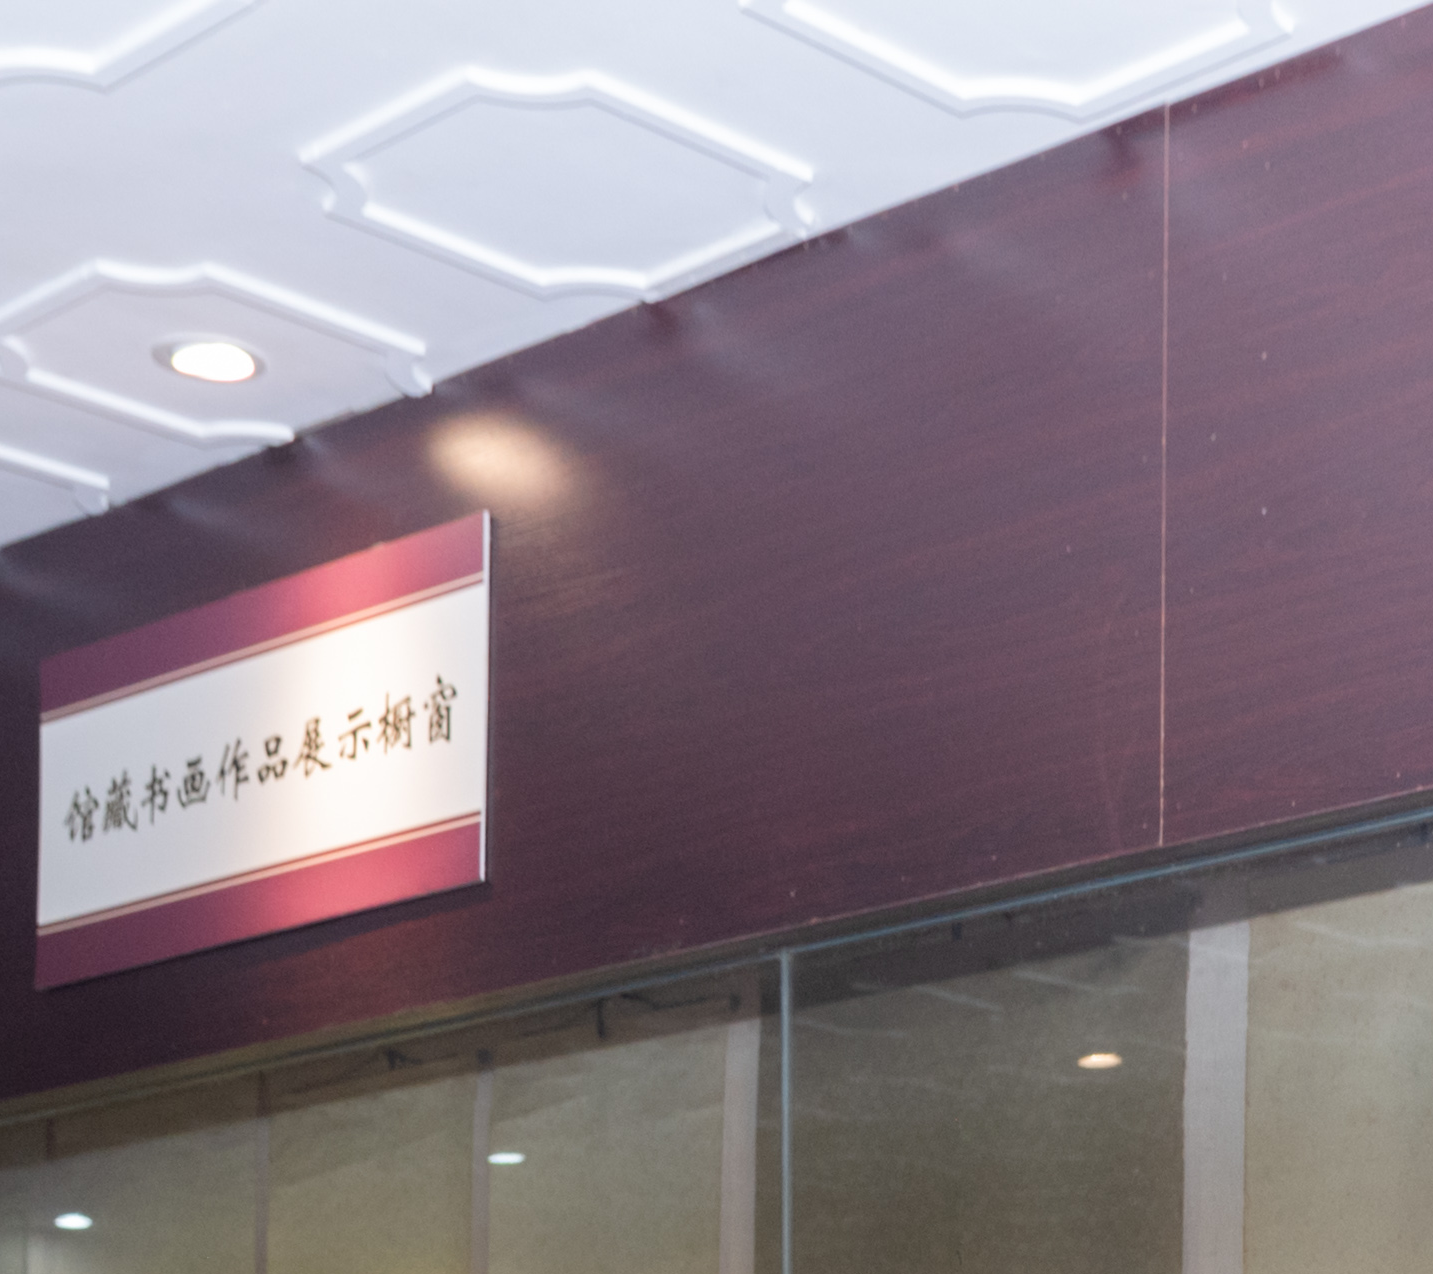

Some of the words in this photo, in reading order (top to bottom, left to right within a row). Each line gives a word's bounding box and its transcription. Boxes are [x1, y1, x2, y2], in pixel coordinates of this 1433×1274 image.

[63, 673, 459, 845] 馆藏书画作品展示橱窗
